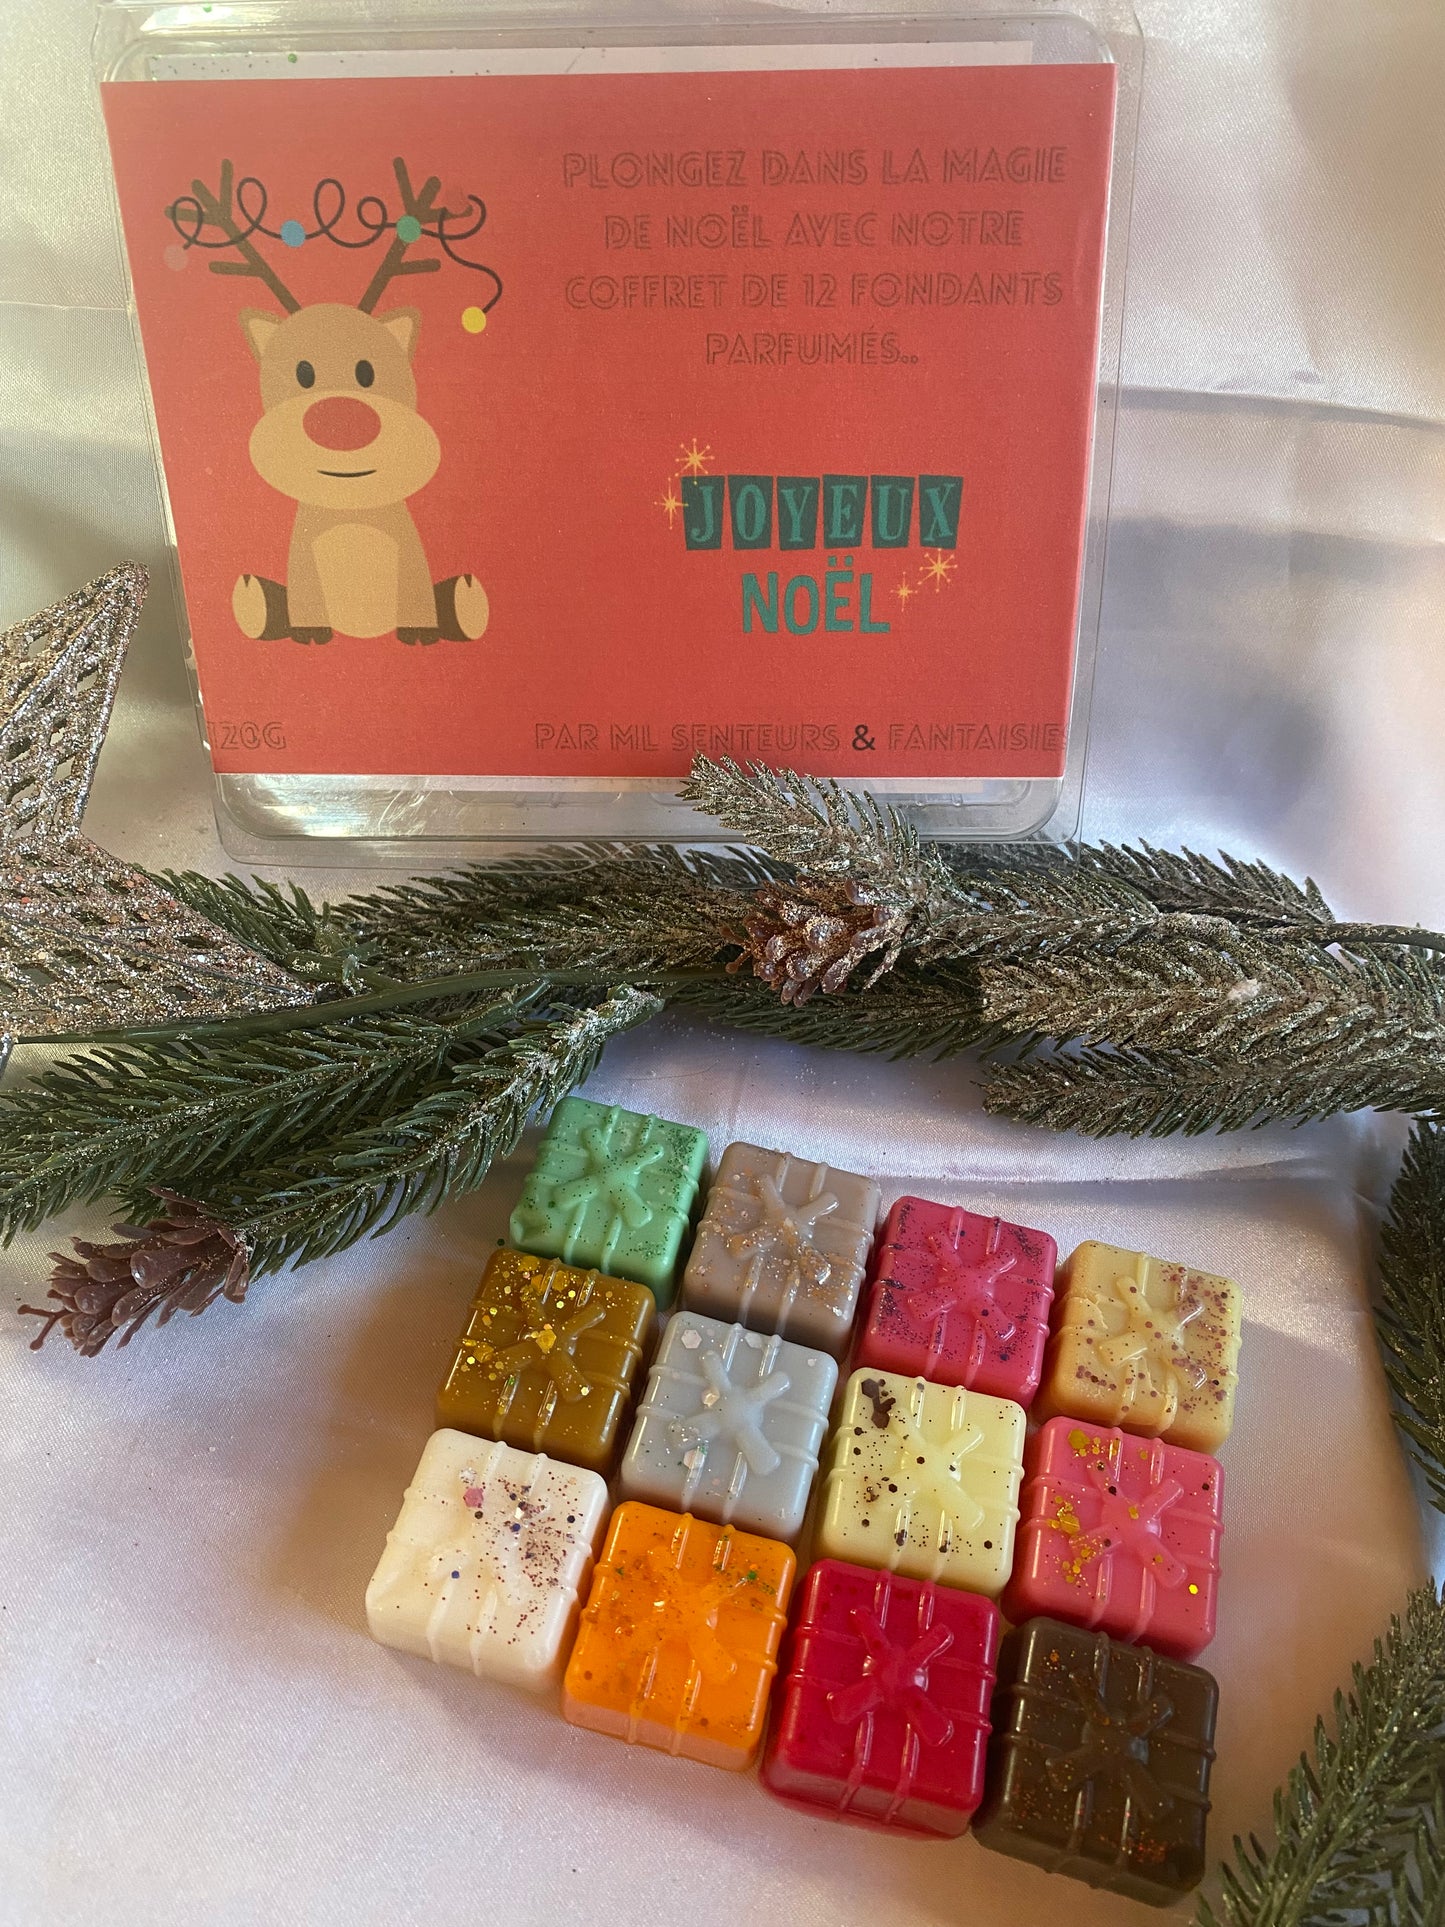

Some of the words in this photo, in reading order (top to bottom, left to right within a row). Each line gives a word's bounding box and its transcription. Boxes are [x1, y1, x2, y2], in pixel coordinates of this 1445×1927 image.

[563, 151, 746, 188] PLONGEZ
[763, 149, 869, 186] DANS
[882, 148, 930, 184] LA
[943, 146, 1068, 183] MAGIE
[605, 214, 650, 250] DE
[666, 205, 771, 249] NOËL
[785, 212, 879, 248] AVEC
[892, 210, 1024, 246] NOTRE
[565, 275, 729, 310] COFFRET
[742, 274, 789, 308] DE
[801, 274, 838, 307] 12
[851, 271, 1063, 307] FONDANTS
[690, 483, 957, 543] JOYEUX
[742, 555, 890, 634] NOËL
[535, 723, 599, 749] PAR
[610, 724, 659, 751] ML
[671, 723, 840, 751] SENTEURS
[852, 724, 876, 751] &
